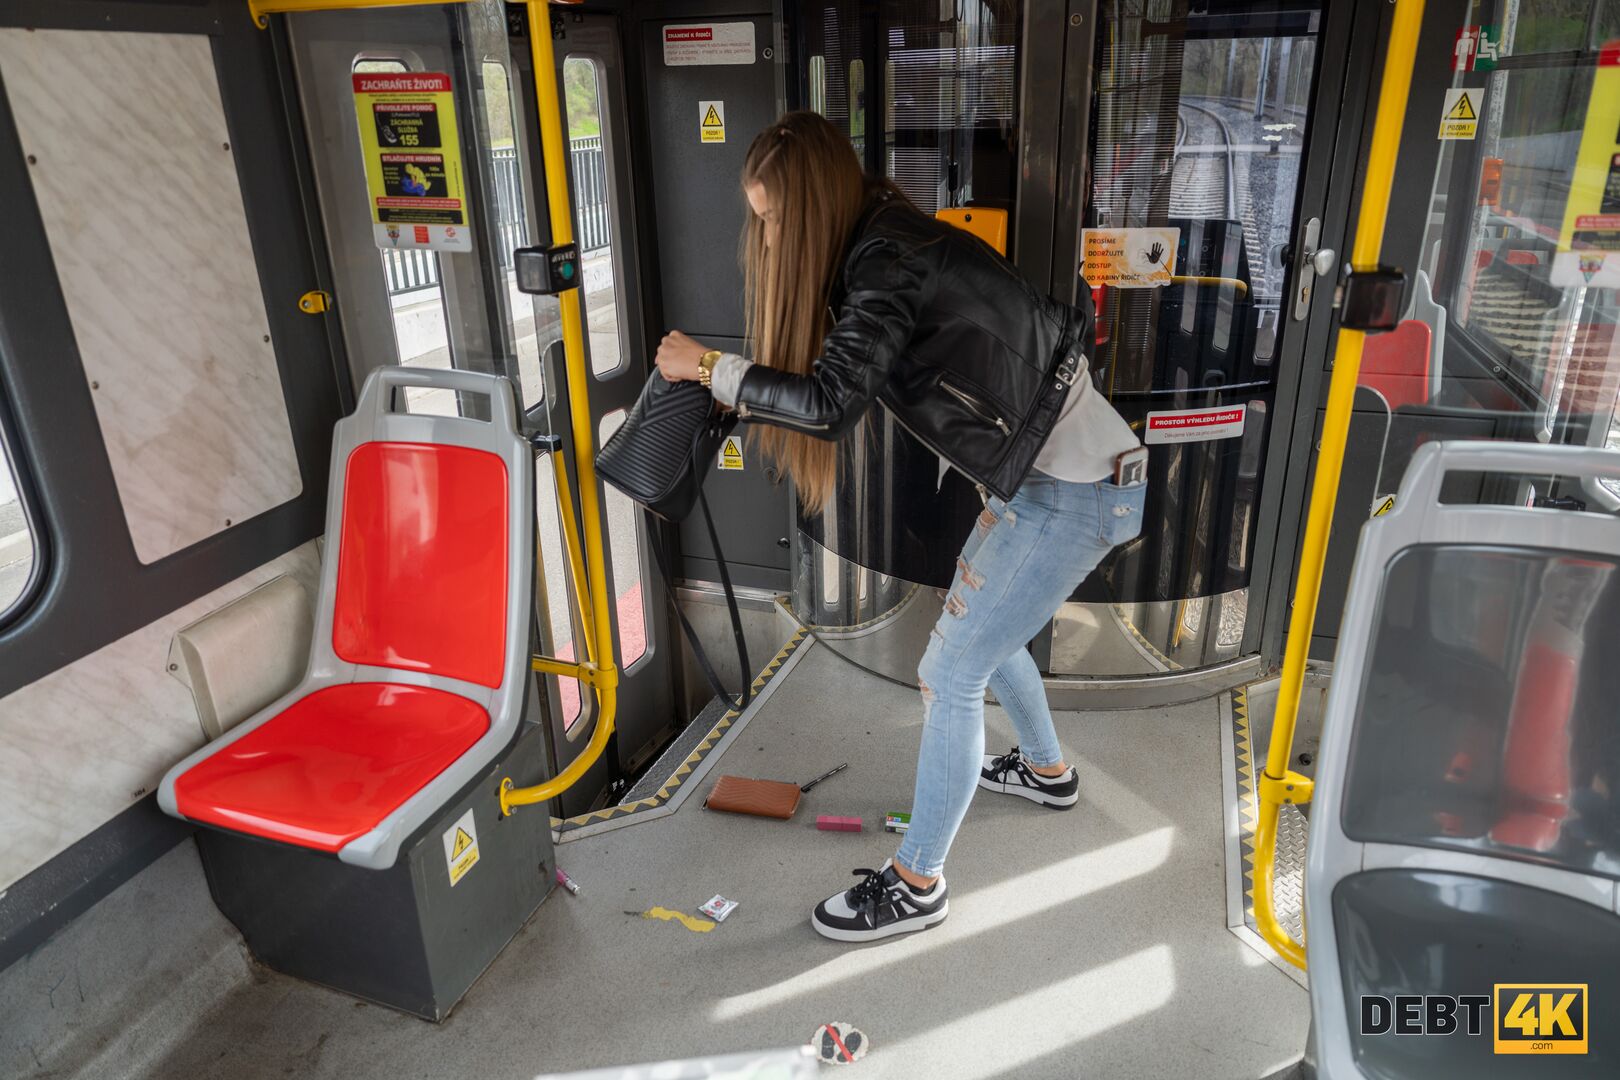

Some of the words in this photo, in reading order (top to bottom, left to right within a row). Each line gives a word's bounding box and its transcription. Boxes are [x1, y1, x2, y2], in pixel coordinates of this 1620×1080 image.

[360, 78, 413, 91] ZACHRAŇTE
[413, 77, 443, 91] ŽIVOT!
[376, 104, 411, 112] PŘIVOLEJTE
[390, 117, 424, 126] ZÁCHRANNÁ
[397, 126, 418, 134] SLUŽBA
[399, 134, 419, 146] 155
[1155, 418, 1186, 426] PROSTOR
[1186, 416, 1215, 424] VÝHLEDU
[1215, 413, 1235, 422] ŘIDIČE
